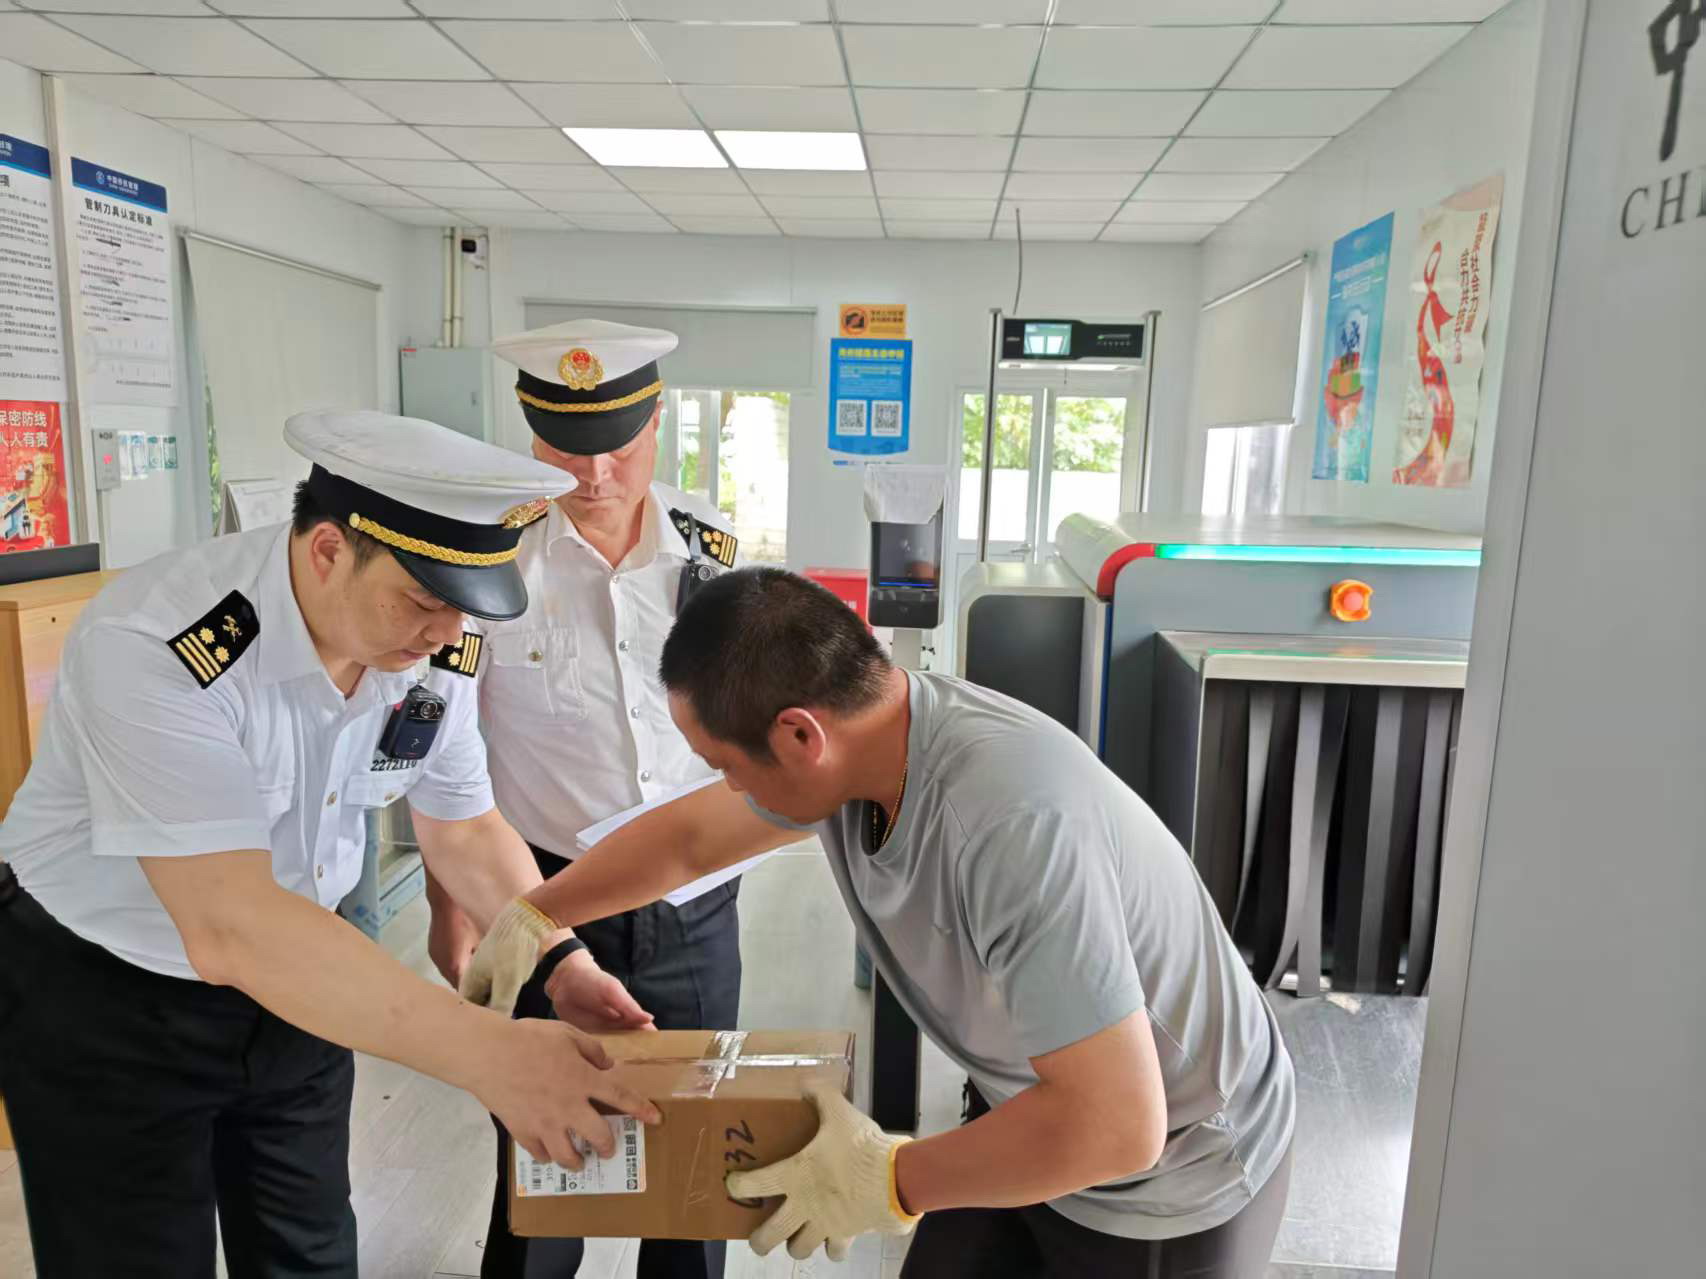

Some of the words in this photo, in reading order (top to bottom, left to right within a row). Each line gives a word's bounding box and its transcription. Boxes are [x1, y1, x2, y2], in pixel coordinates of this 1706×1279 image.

[84, 197, 152, 226] 管制刀具认定标准
